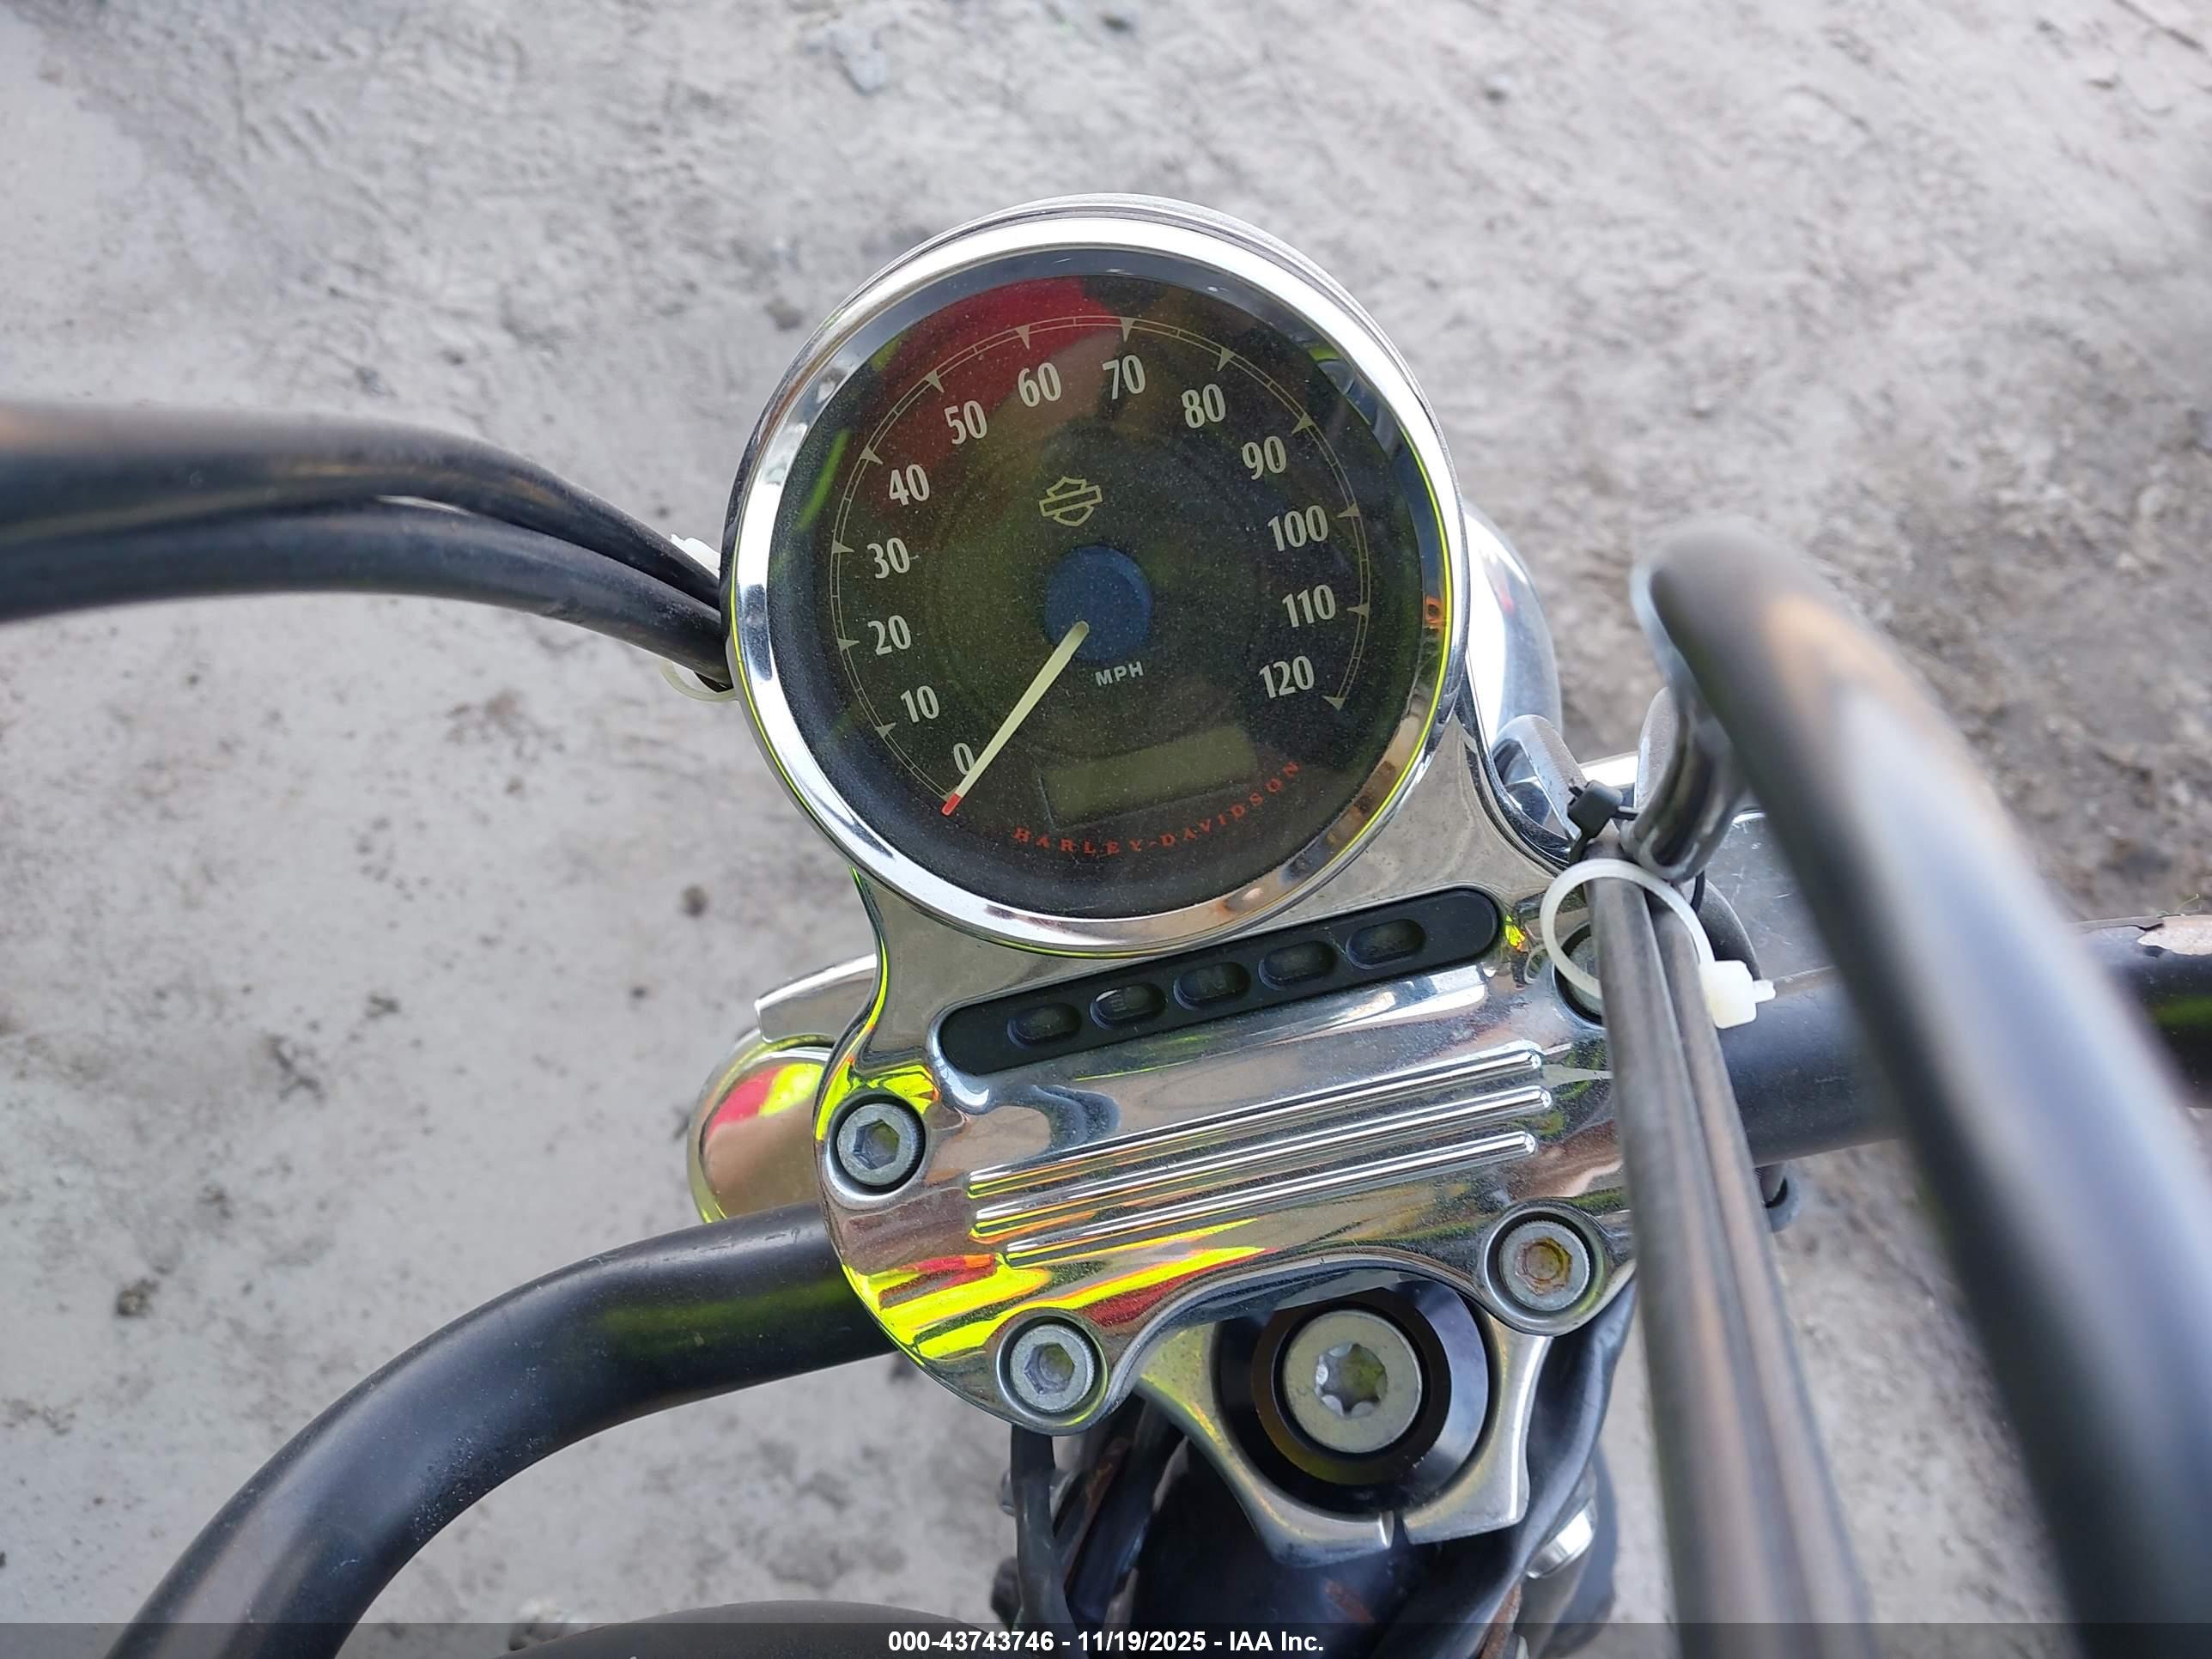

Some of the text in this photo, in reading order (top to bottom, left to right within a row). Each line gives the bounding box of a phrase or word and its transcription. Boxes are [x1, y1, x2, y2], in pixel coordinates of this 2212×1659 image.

[1018, 362, 1062, 407] 60
[1103, 356, 1146, 399] 70
[945, 400, 988, 444] 50
[1182, 384, 1225, 428] 80
[1242, 435, 1286, 480] 90
[889, 464, 930, 505] 40
[1268, 505, 1328, 551] 100
[867, 538, 910, 578] 30
[1282, 585, 1335, 628] 110
[868, 616, 911, 655] 20
[1096, 661, 1144, 686] MPH
[1260, 656, 1315, 700] 120
[901, 685, 939, 725] 10
[953, 743, 974, 775] 0
[1013, 762, 1299, 854] HARLEY-DAVIDSON
